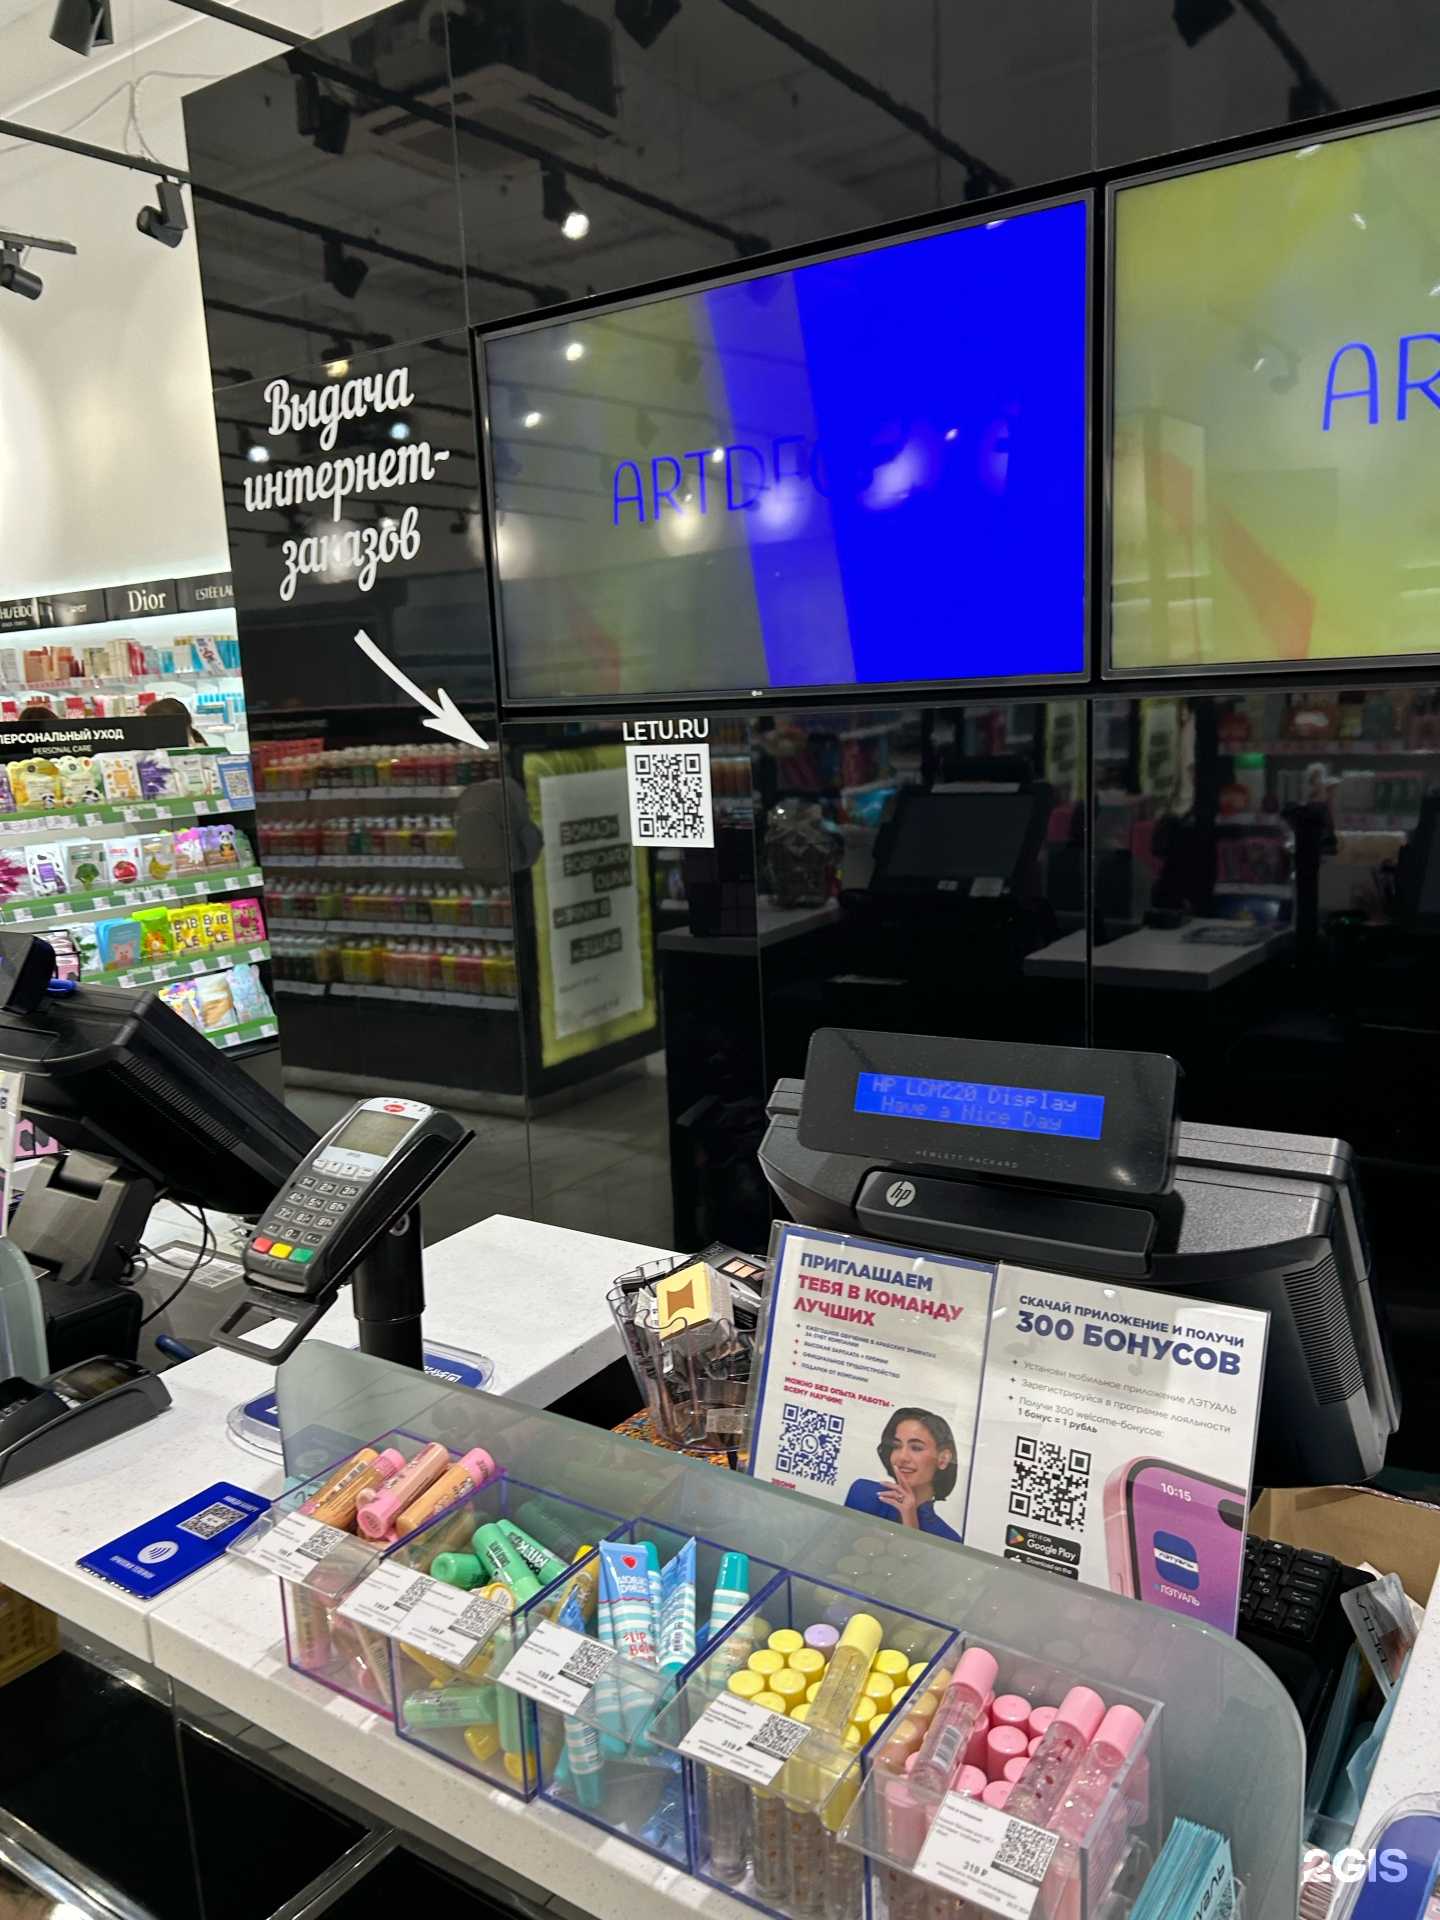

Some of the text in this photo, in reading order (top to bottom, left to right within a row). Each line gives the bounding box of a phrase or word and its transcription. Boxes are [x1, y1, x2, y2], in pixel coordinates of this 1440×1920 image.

[263, 367, 415, 451] Выдача
[243, 441, 450, 522] интернет-
[280, 506, 421, 601] заказов
[128, 589, 166, 612] Dior
[93, 728, 124, 740] УХОД
[622, 718, 709, 741] LETU.RU
[872, 1076, 895, 1093] HP
[988, 1086, 1077, 1112] Display
[881, 1095, 928, 1116] Have
[961, 1104, 1011, 1126] Nice
[1023, 1110, 1063, 1130] Day
[799, 1252, 933, 1292] ПРИГЛАШАЕМ
[793, 1296, 877, 1327] ЛУЧШИХ
[798, 1274, 964, 1323] ТЕБЯ В КОМАНДУ
[1019, 1295, 1245, 1347] СКАЧАЙ ПРИЛОЖЕНИЕ И ПОЛУЧИ
[1016, 1309, 1241, 1376] 300 БОНУСОВ
[1024, 1360, 1237, 1415] Установи мобильное приложение ЛЭТУАЛЬ
[1024, 1410, 1053, 1423] бонус
[1069, 1421, 1098, 1433] рубль
[1056, 1405, 1074, 1416] 300
[1170, 1414, 1231, 1433] лояльности
[1161, 1483, 1192, 1502] 10:15
[1026, 1539, 1076, 1561] Google Play
[1160, 1584, 1200, 1607] ЛЭТУАЛЬ
